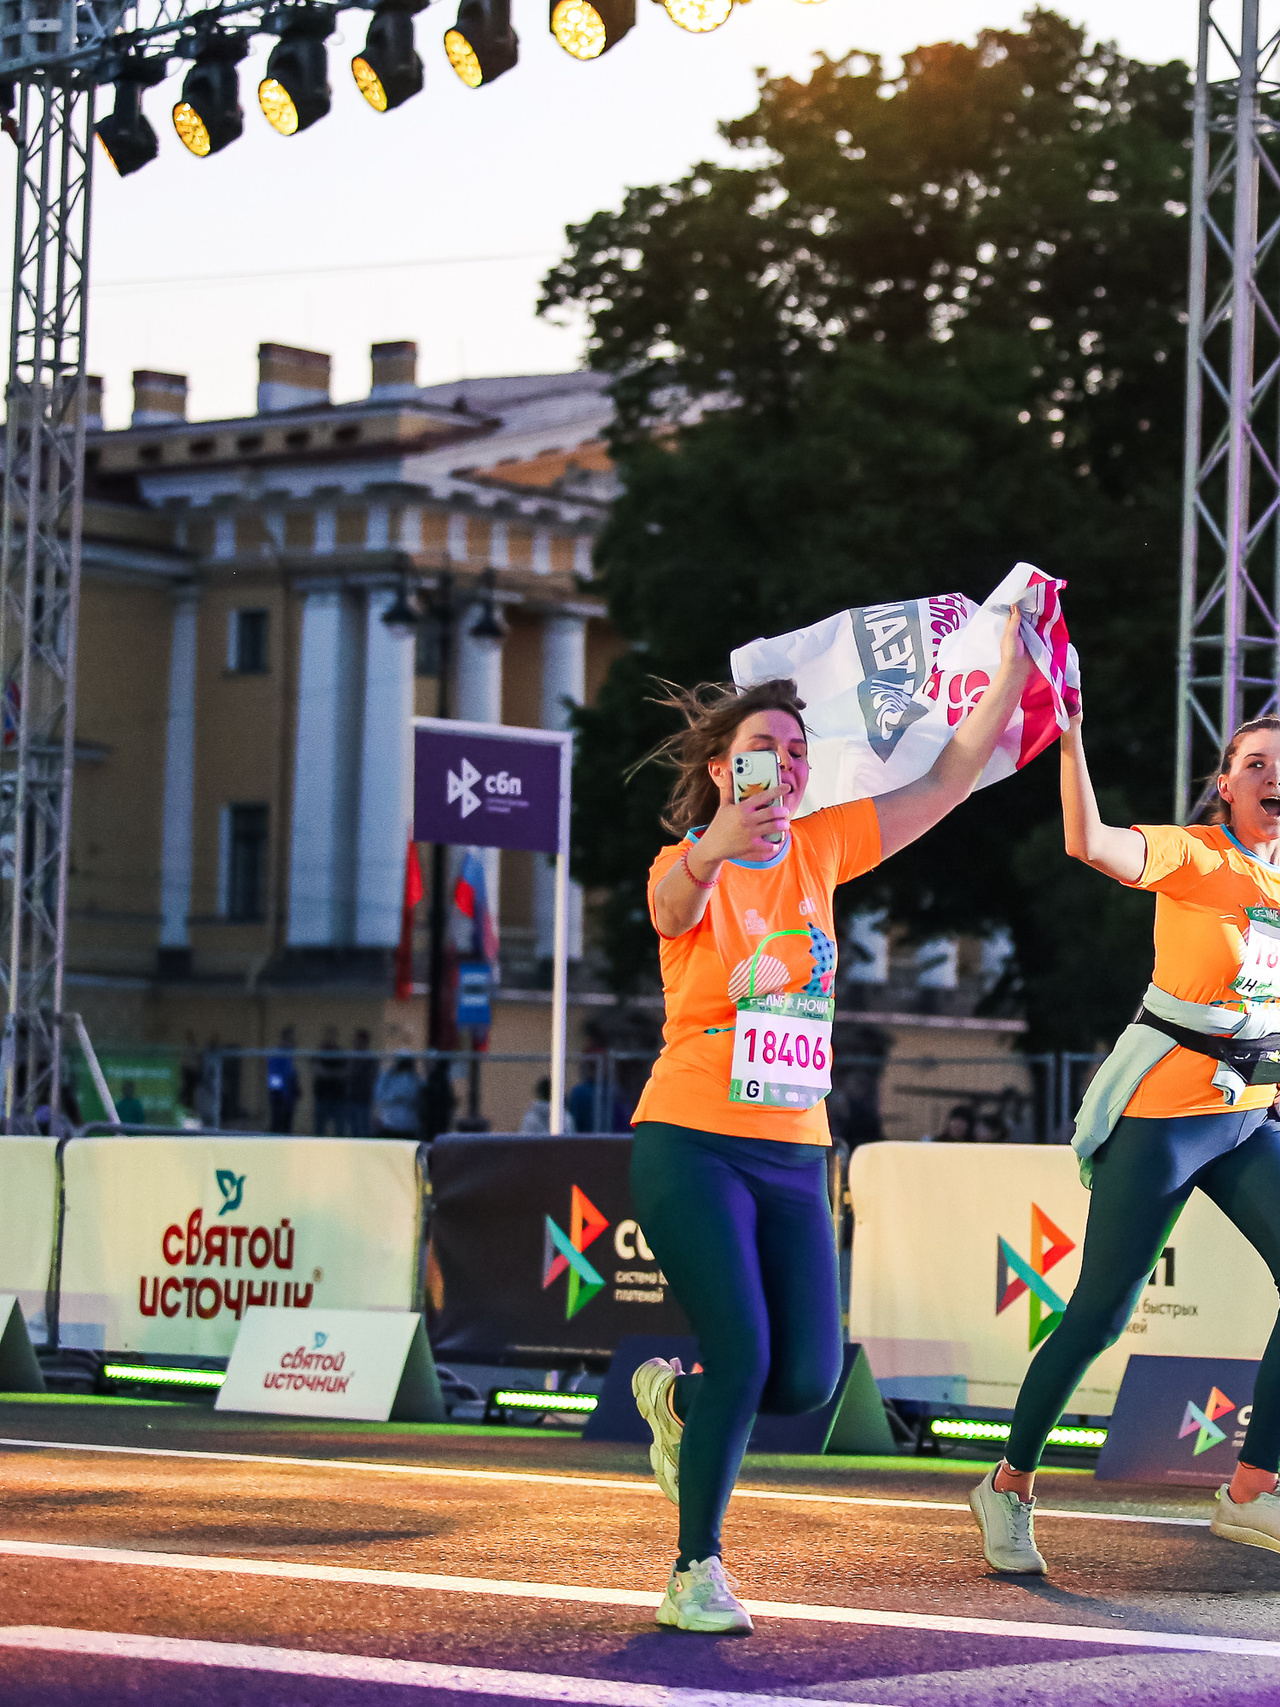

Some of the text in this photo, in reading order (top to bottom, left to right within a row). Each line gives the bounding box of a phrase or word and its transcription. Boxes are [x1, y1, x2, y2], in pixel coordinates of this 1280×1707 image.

[796, 998, 829, 1014] НОЧИ
[744, 1028, 826, 1071] 18406
[746, 1080, 760, 1098] G
[1142, 1298, 1199, 1319] быстрых
